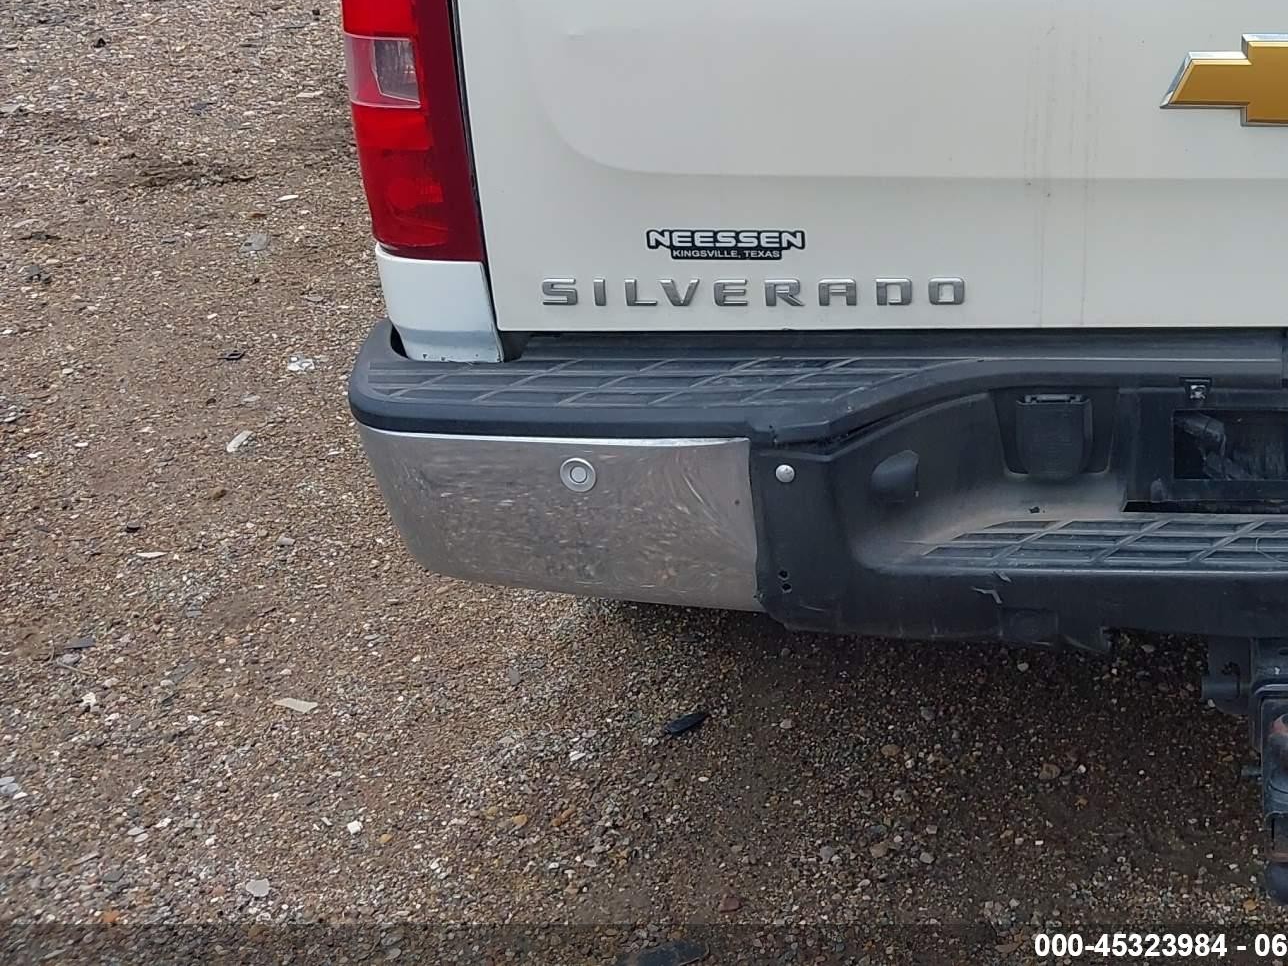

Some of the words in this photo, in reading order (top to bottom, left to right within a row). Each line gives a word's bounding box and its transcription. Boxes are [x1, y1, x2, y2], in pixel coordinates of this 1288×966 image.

[648, 230, 804, 249] NEESSEN
[672, 248, 741, 259] KINGSVILLE,
[744, 249, 780, 258] TEXAS
[541, 277, 966, 307] SILVERADO
